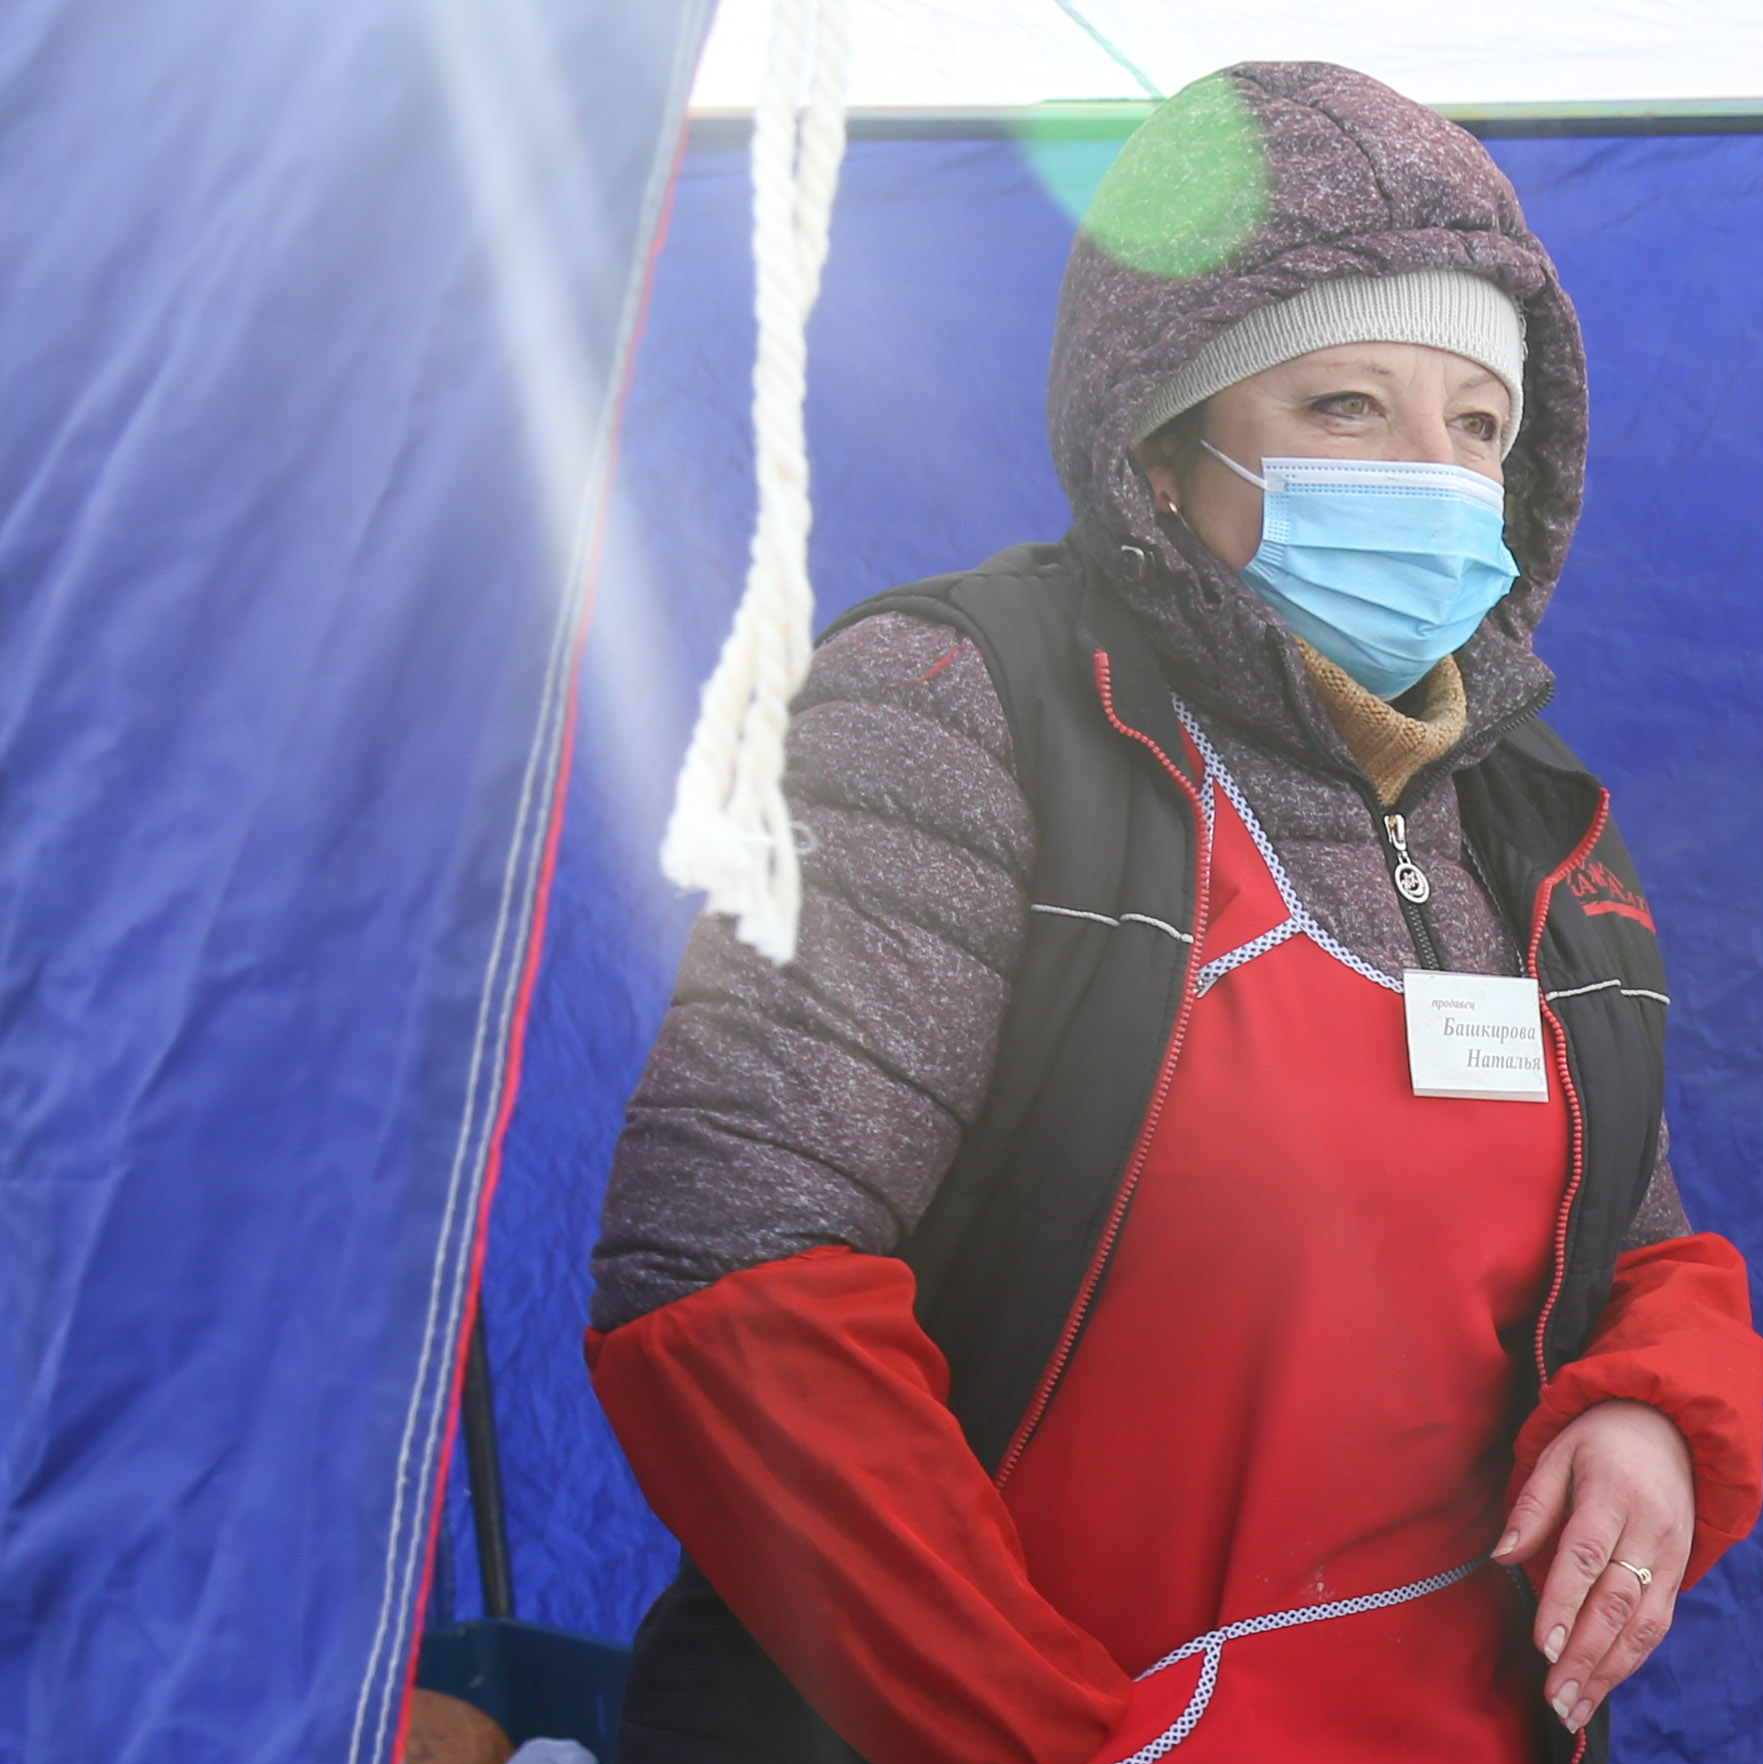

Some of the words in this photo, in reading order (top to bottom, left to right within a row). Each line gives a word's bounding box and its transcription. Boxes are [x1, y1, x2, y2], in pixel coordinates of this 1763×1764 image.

[1431, 997, 1475, 1012] продавец
[1442, 1017, 1536, 1044] Башкирова
[1466, 1048, 1541, 1071] Наталья
